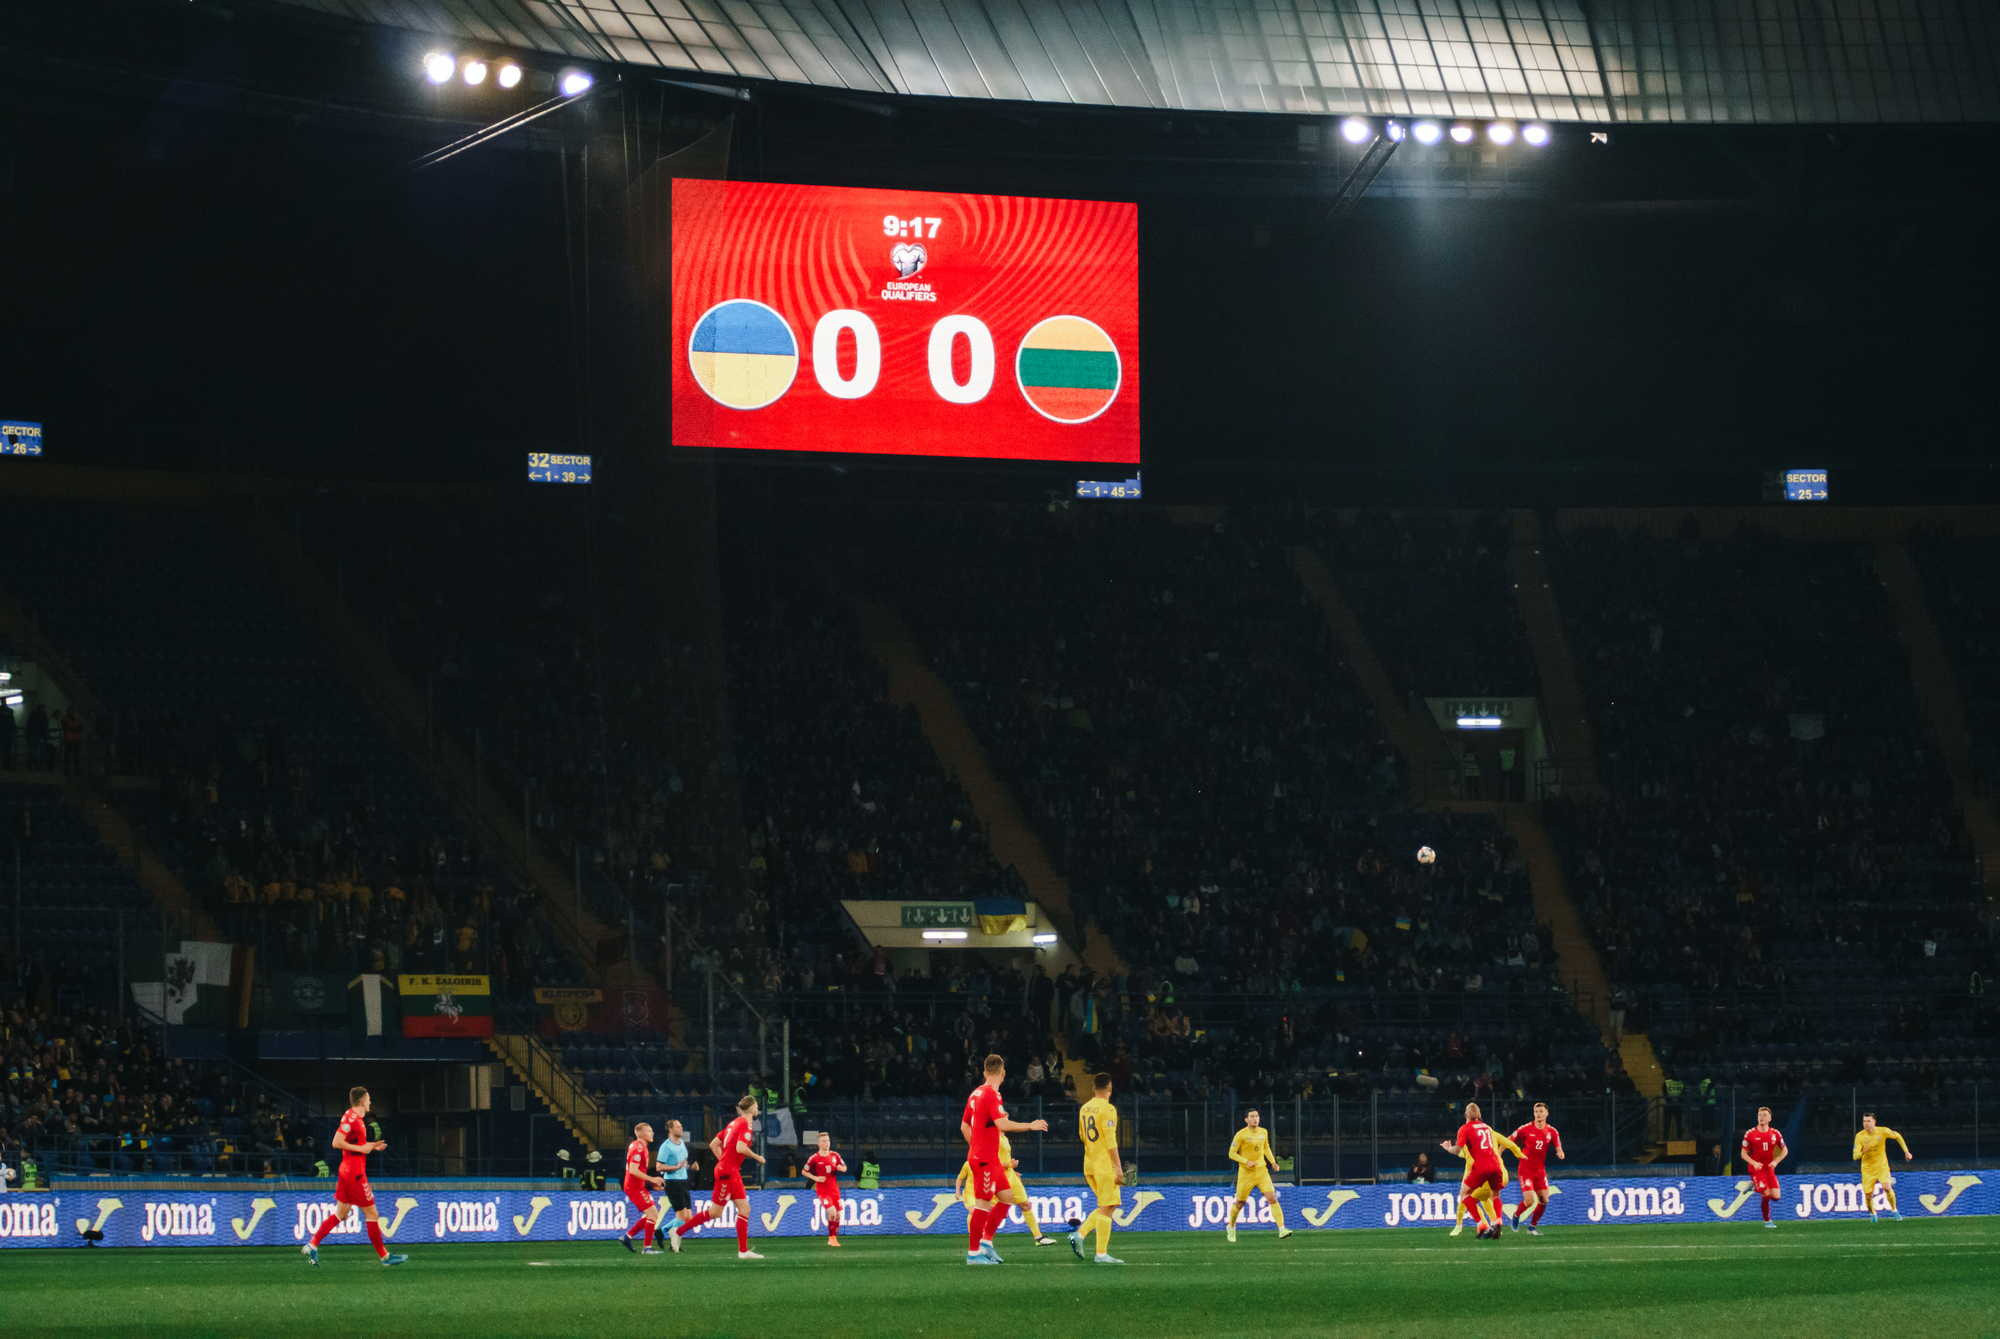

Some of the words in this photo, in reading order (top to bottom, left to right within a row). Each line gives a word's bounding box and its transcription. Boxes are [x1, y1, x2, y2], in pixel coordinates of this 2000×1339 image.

[883, 215, 942, 239] 9:17
[887, 281, 931, 292] EUROPEAN
[881, 289, 937, 302] QUALIFIERS
[812, 309, 881, 399] 0
[927, 314, 996, 404] 0
[528, 453, 549, 467] 32
[550, 456, 591, 465] SECTOR
[545, 472, 551, 481] 1
[1786, 474, 1827, 482] SECTOR
[1111, 487, 1125, 497] 45
[1798, 490, 1812, 500] 25
[1082, 1115, 1099, 1142] 18
[1535, 1140, 1544, 1150] 22
[998, 1195, 1087, 1227] oma
[0, 1203, 59, 1236] oma
